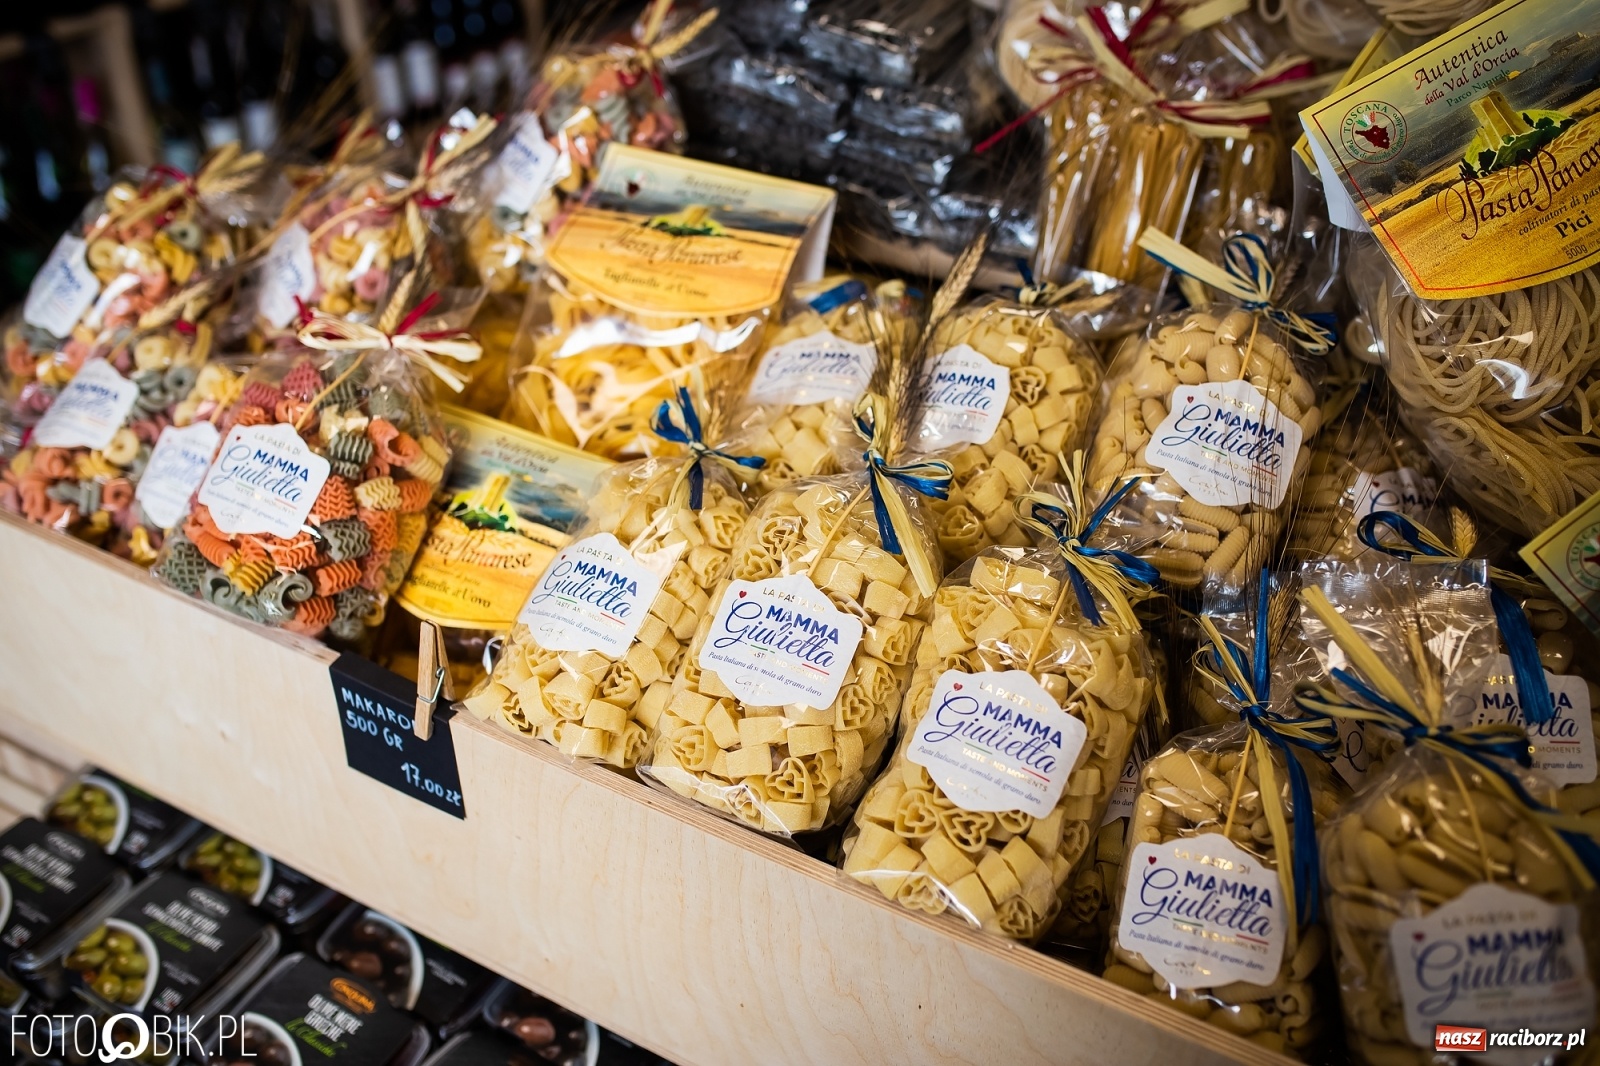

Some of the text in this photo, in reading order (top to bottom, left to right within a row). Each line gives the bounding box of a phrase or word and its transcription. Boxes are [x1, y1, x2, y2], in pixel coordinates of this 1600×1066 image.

[1415, 29, 1508, 90] Autentica
[1424, 88, 1444, 106] della
[1443, 74, 1471, 91] Val
[1446, 68, 1511, 107] Parco Naturale
[1344, 103, 1388, 133] TOSCANA
[1519, 203, 1568, 236] coltivatori
[1570, 196, 1582, 210] di
[1554, 210, 1593, 238] Pici
[1565, 244, 1588, 259] 500g
[935, 372, 995, 390] MAMMA
[1208, 390, 1221, 400] LA
[1224, 395, 1256, 414] PASTA
[1162, 404, 1282, 469] Giulietta
[1214, 408, 1285, 448] MAMMA
[210, 444, 303, 502] Giulietta
[254, 449, 309, 482] MAMMA
[1156, 448, 1174, 460] Pasta
[1174, 454, 1199, 469] Italiana
[1200, 464, 1207, 472] di
[1208, 466, 1230, 480] semola
[586, 547, 613, 562] PASTA
[532, 560, 632, 618] Giulietta
[574, 560, 638, 597] MAMMA
[762, 587, 775, 596] LA
[555, 600, 571, 610] TASTE
[582, 625, 601, 638] grano
[602, 630, 617, 645] duro
[714, 599, 835, 668] Giulietta
[766, 605, 839, 644] MAMMA
[708, 651, 723, 661] Pasta
[724, 656, 746, 668] Italiana
[776, 674, 784, 682] di
[784, 678, 806, 690] grano
[806, 686, 822, 697] duro
[1482, 674, 1515, 686] PAST
[342, 687, 415, 730] MAKARO
[980, 681, 993, 694] LA
[996, 688, 1031, 708] PASTA
[346, 710, 404, 752] 500 GR
[924, 691, 1056, 774] Giulietta
[982, 701, 1062, 749] MAMMA
[1537, 746, 1582, 754] MOMENTS
[1542, 762, 1565, 770] grano
[1566, 761, 1583, 770] duro
[918, 746, 934, 756] Pasta
[934, 750, 960, 767] Italiana
[960, 761, 968, 770] di
[968, 764, 994, 782] semola
[994, 776, 1002, 786] di
[1002, 781, 1024, 797] grano
[1024, 790, 1042, 804] duro
[962, 747, 986, 764] TASTE
[1006, 766, 1048, 792] MOMENTS
[1174, 848, 1190, 860] LA
[1194, 854, 1234, 871] PASTA
[1132, 866, 1273, 937] Giulietta
[1184, 870, 1273, 908] MAMMA
[1129, 929, 1147, 940] Pasta
[1147, 931, 1172, 947] Italiana
[1174, 938, 1183, 948] di
[1220, 952, 1244, 966] grano
[1245, 957, 1264, 972] duro
